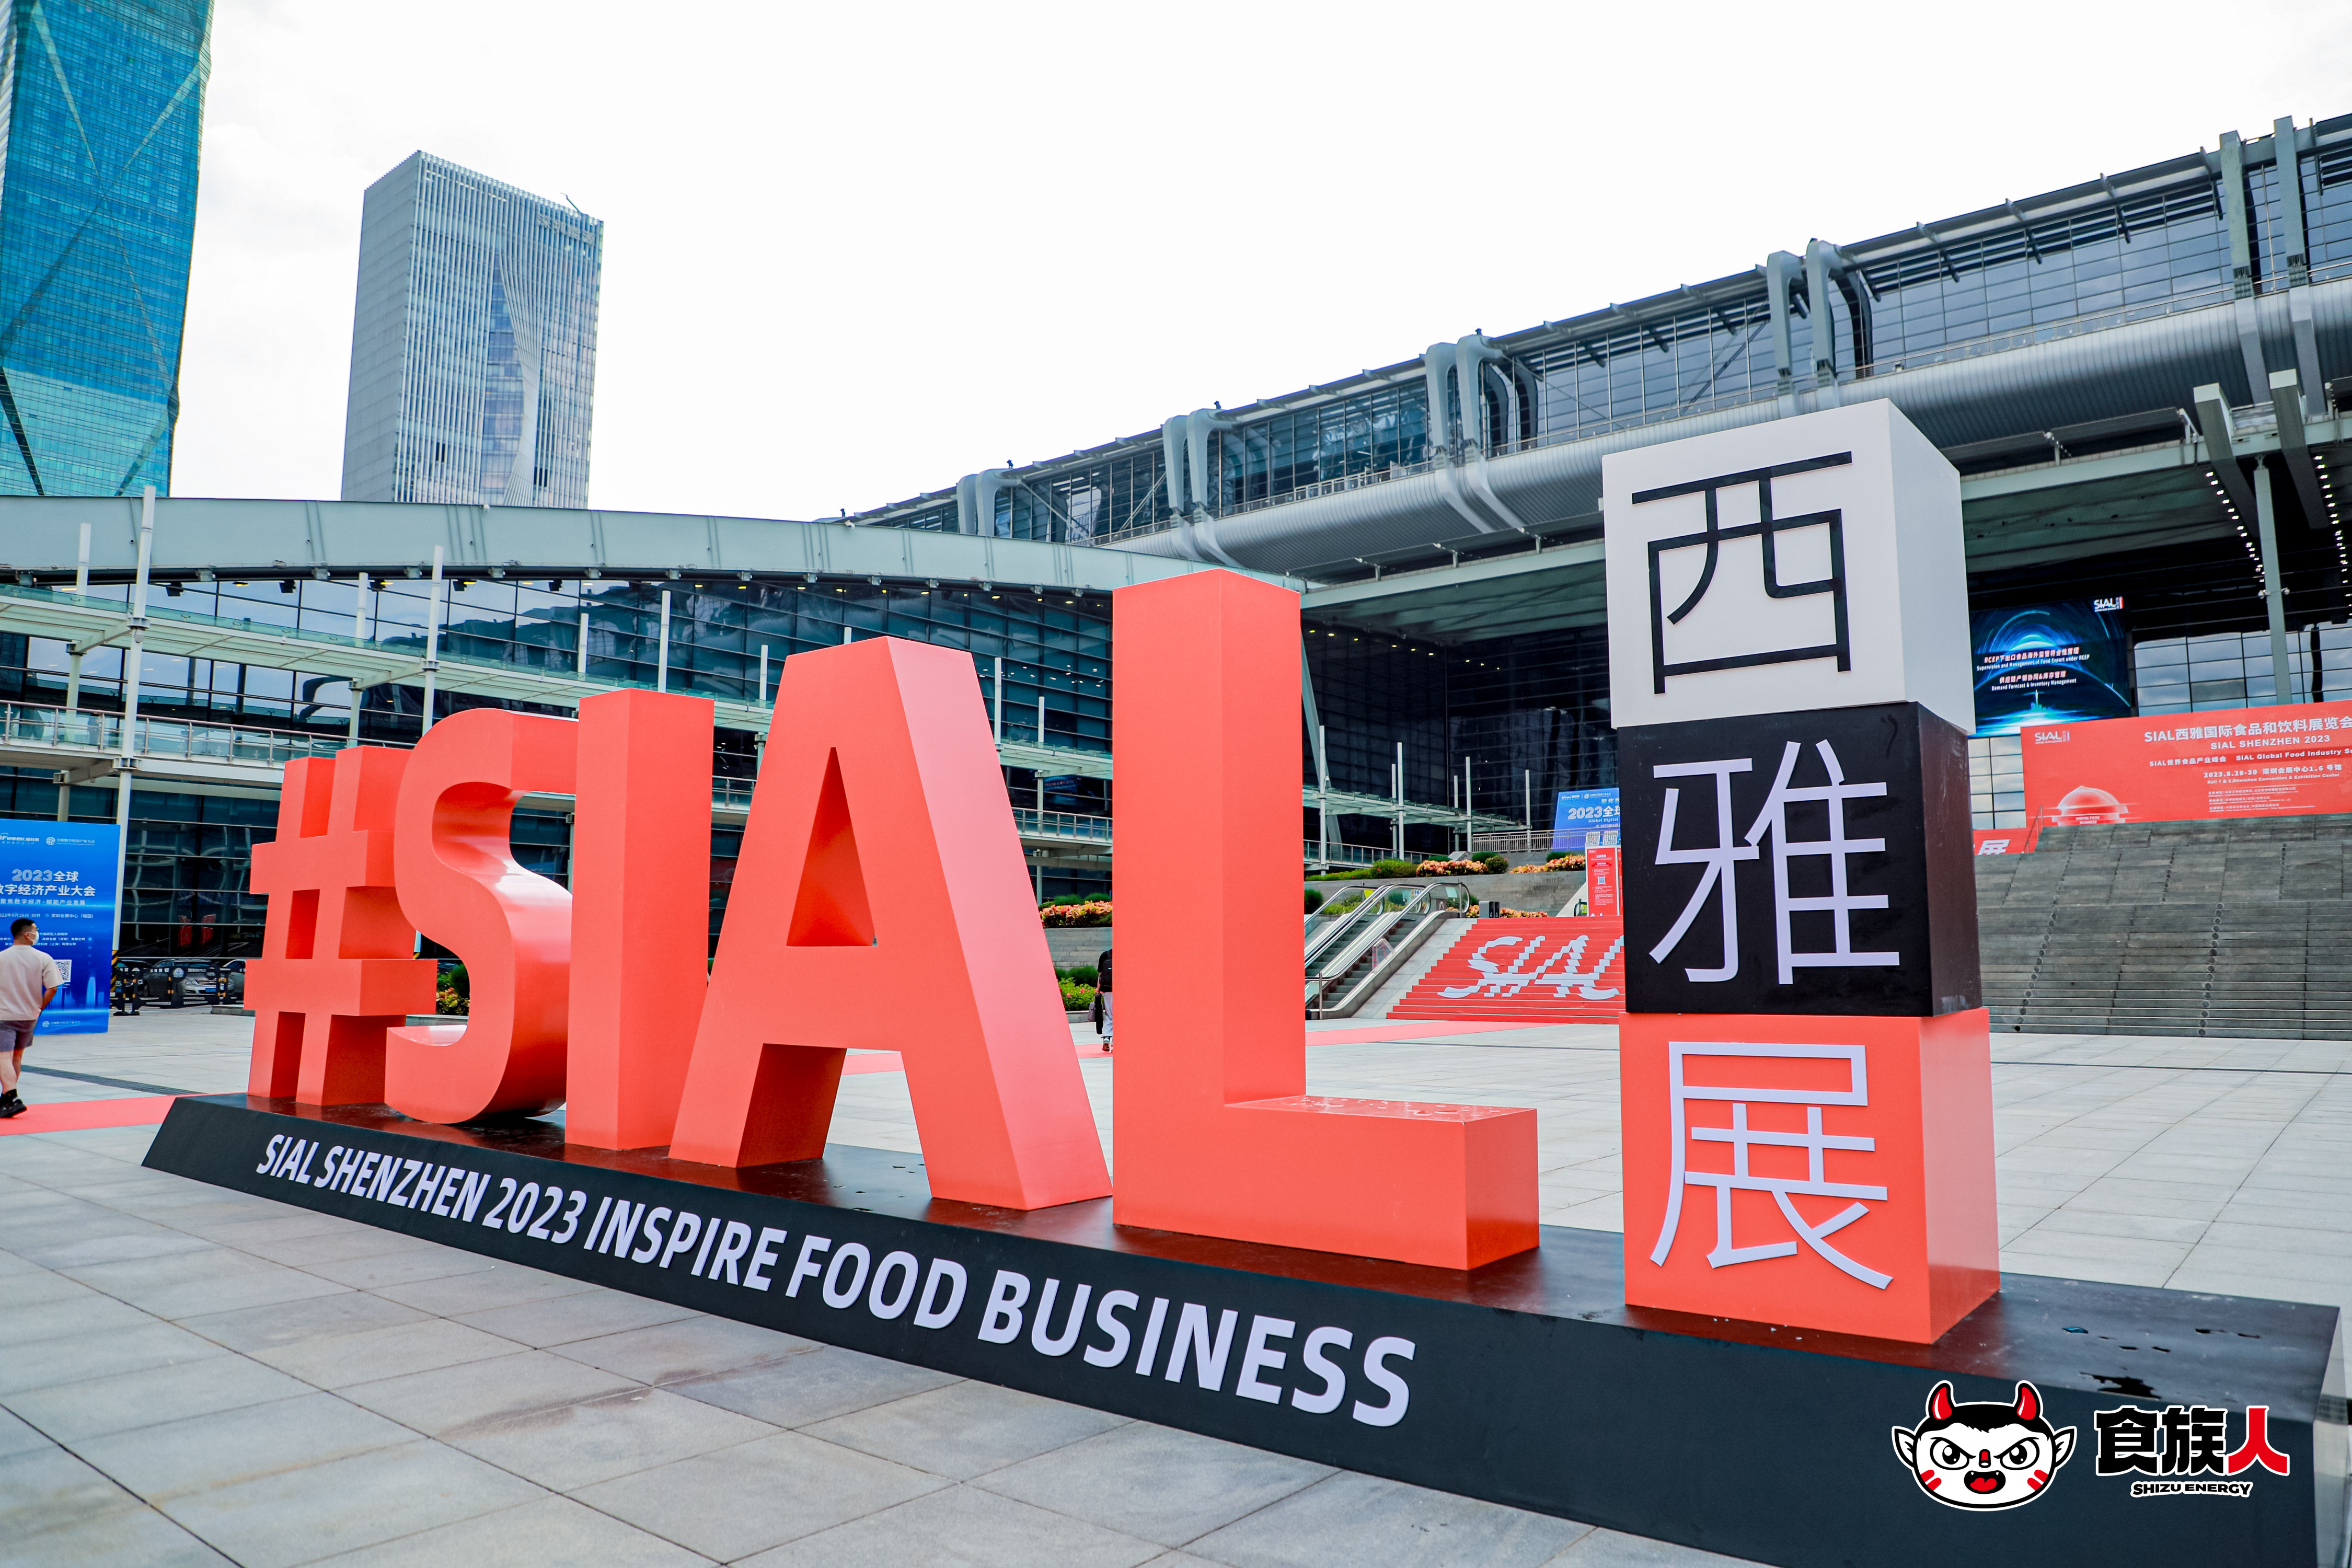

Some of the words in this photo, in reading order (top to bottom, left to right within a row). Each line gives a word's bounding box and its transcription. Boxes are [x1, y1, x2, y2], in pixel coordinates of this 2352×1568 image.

[2094, 598, 2116, 609] SIAL
[2035, 731, 2062, 741] SIAL
[2145, 716, 2352, 743] SIAL西雅国际食品和饮料展览会
[2239, 737, 2300, 748] SHENZHEN
[2304, 735, 2331, 743] 2023
[2149, 756, 2227, 767] SIAL世界食品产业峰会
[2204, 769, 2257, 778] 2023.8.28-30
[12, 869, 79, 882] 2023全球
[1632, 452, 1901, 1289] 西雅展
[244, 569, 1539, 1270] #SIAL
[1437, 935, 1624, 1000] SIAL
[256, 1133, 320, 1185] SIAL
[314, 1145, 491, 1223] SHENZHEN
[482, 1177, 586, 1244] 2023
[582, 1195, 788, 1292] INSPIRE
[785, 1233, 968, 1330] FOOD
[977, 1268, 1417, 1427] BUSINESS
